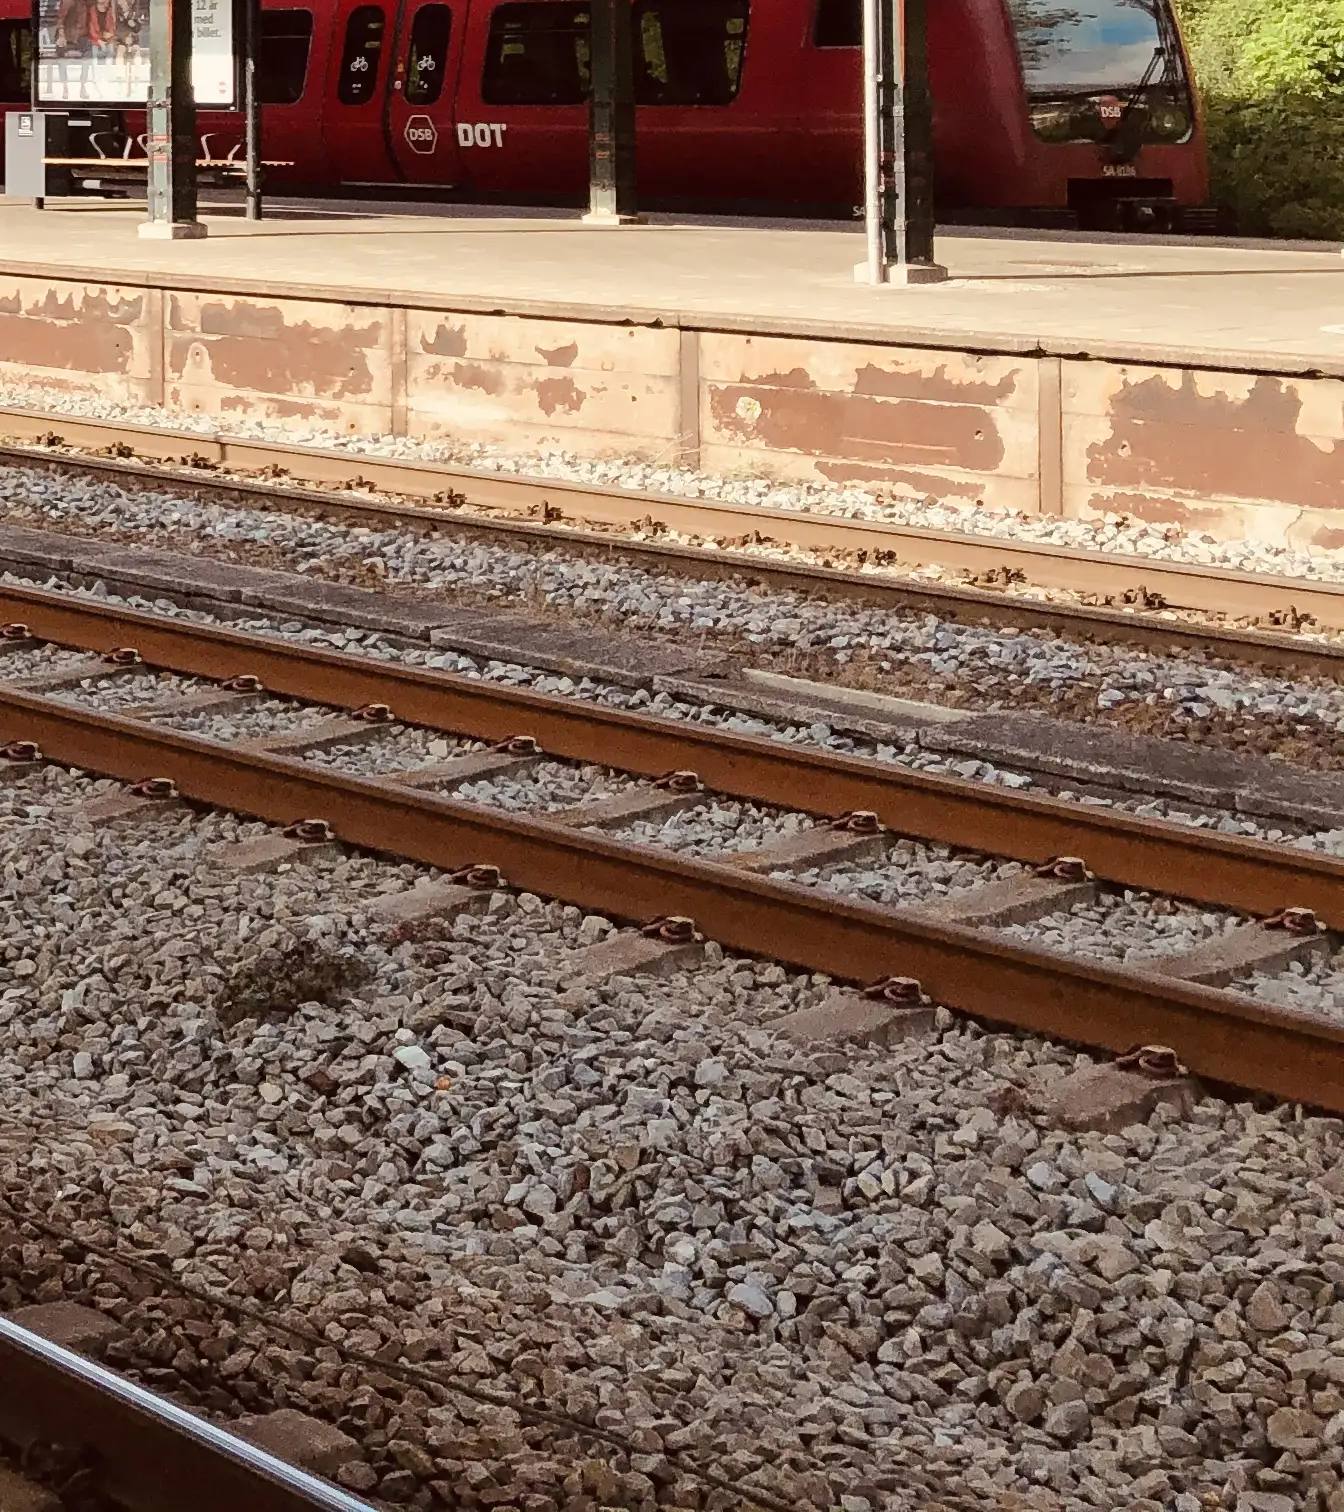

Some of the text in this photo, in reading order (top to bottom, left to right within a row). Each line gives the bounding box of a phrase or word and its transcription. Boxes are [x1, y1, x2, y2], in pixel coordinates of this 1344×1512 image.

[196, 0, 207, 10] 12
[194, 14, 213, 25] med
[196, 27, 222, 38] billet.
[1100, 106, 1122, 118] DSB
[409, 128, 433, 141] DSB
[457, 122, 507, 148] DOT
